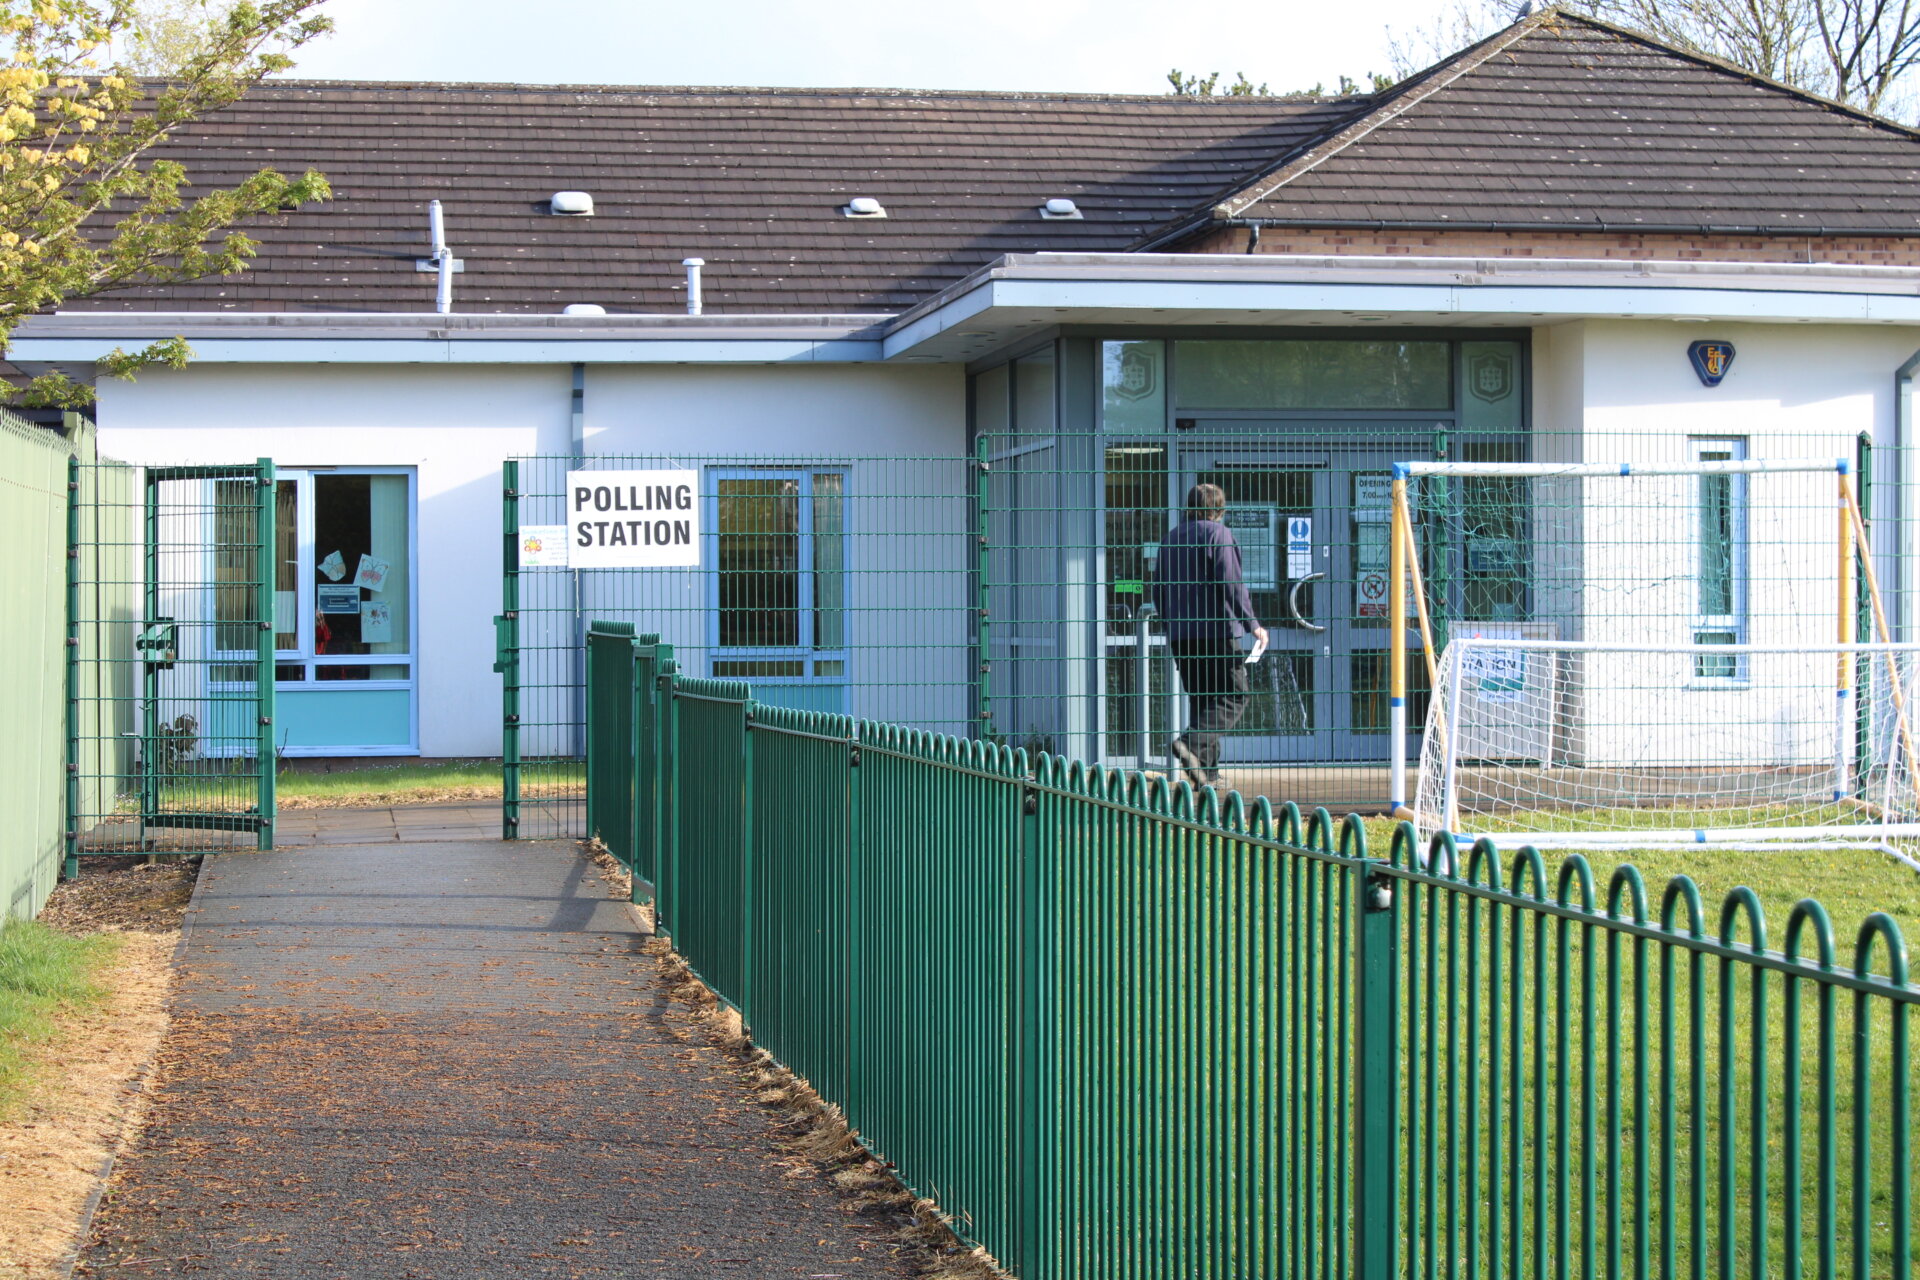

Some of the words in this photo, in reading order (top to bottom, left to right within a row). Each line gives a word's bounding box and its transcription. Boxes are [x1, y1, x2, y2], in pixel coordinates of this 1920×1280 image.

[1359, 480, 1391, 488] OPENING
[575, 484, 691, 512] POLLING
[577, 519, 690, 547] STATION
[1462, 659, 1516, 671] STAION
